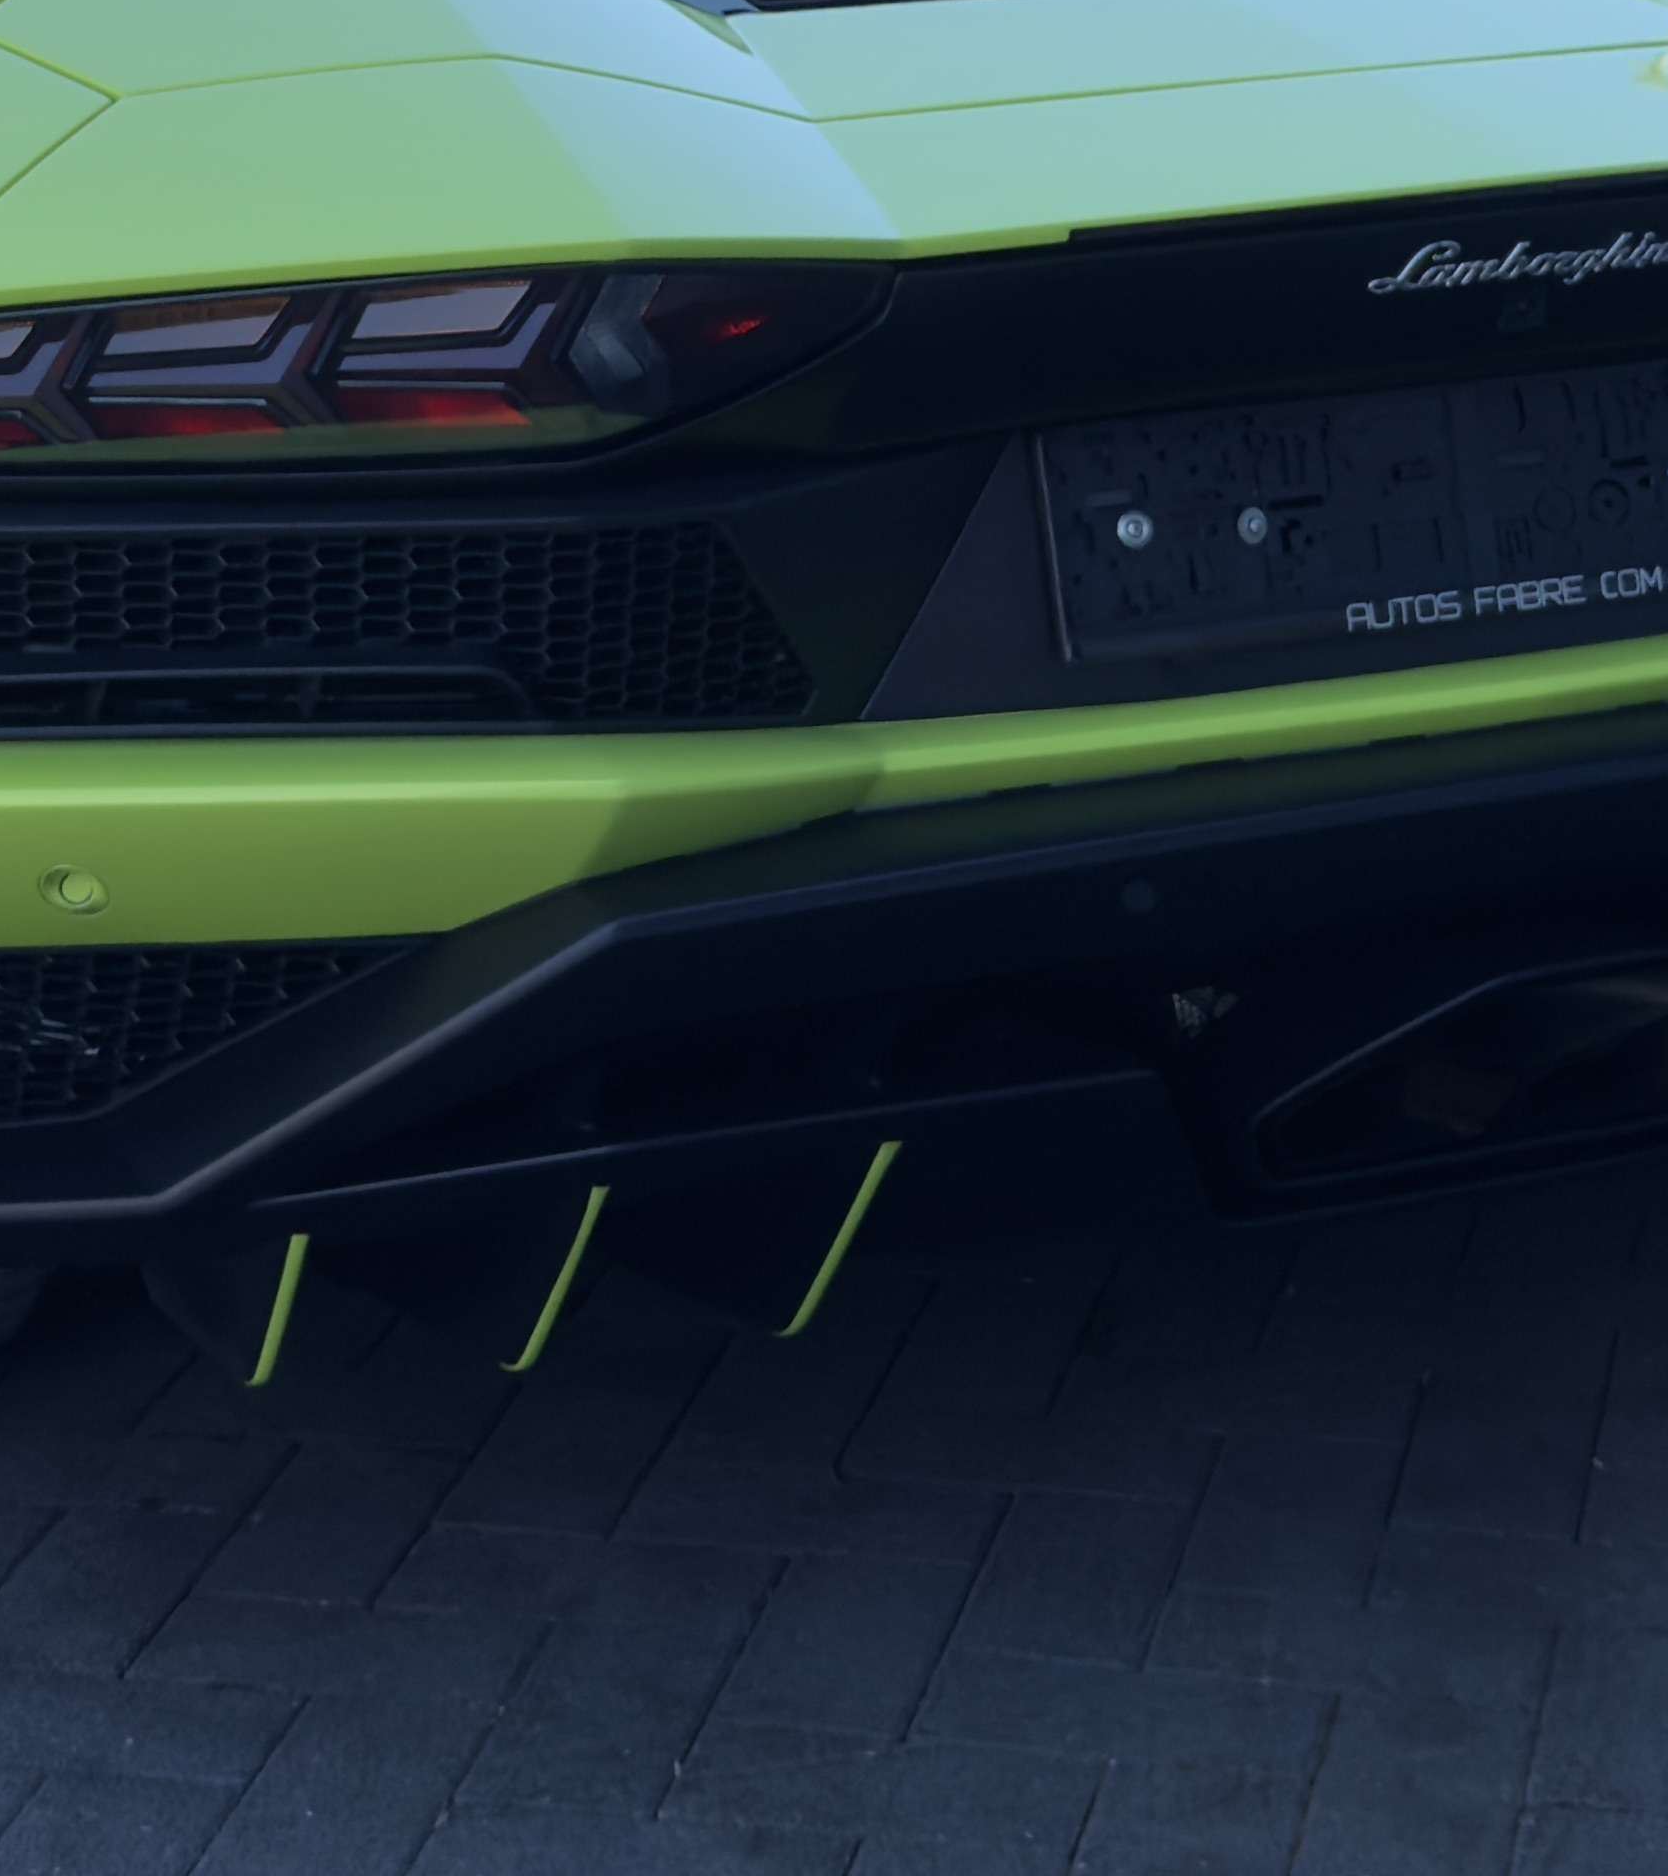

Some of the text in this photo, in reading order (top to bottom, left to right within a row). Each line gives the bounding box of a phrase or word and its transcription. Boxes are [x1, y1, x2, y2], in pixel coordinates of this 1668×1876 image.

[1345, 566, 1665, 632] AUTOS FABRE COM
